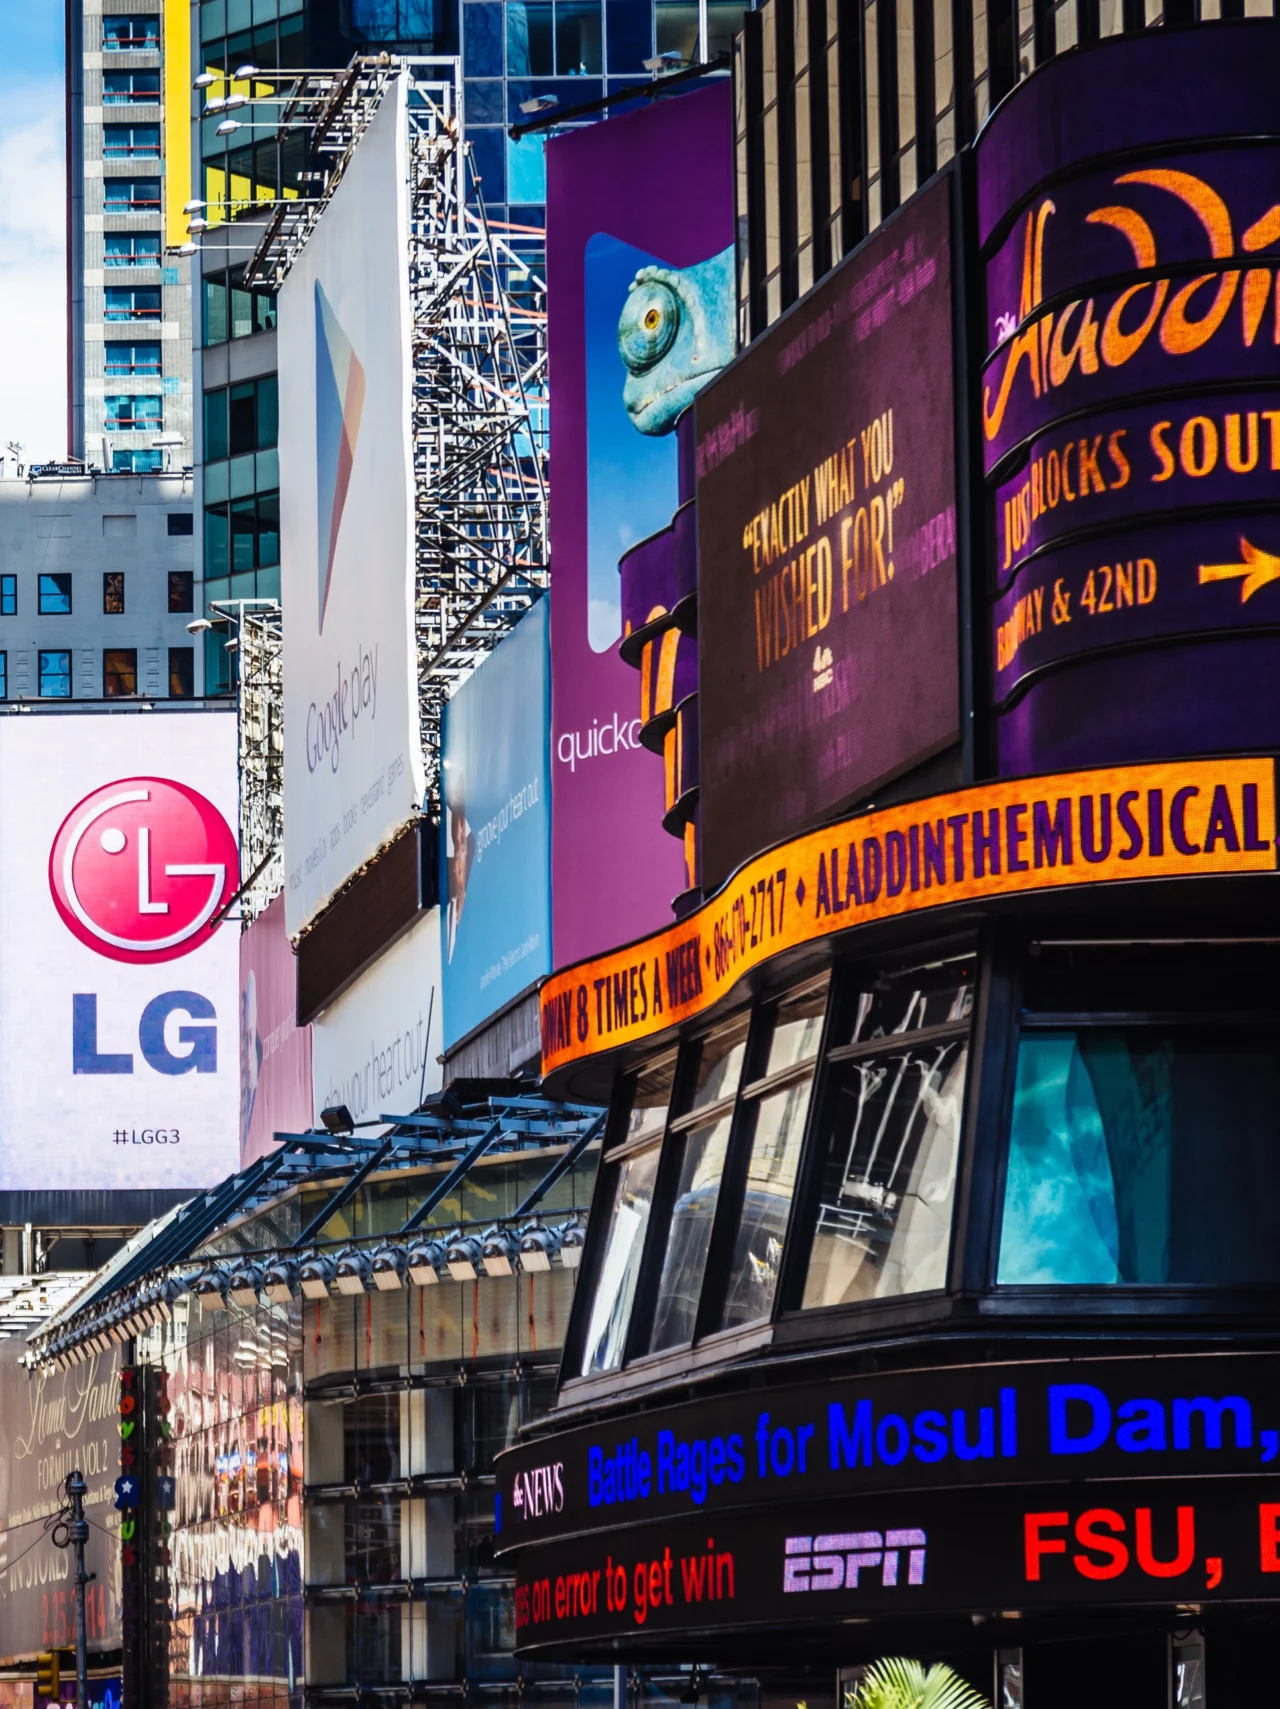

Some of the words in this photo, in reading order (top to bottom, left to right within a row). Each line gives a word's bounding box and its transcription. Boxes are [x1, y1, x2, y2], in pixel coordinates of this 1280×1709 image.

[983, 169, 1280, 441] Aladdi
[814, 437, 857, 527] WHAT
[860, 407, 895, 490] YOU
[1003, 480, 1031, 571] JUS
[1030, 427, 1132, 523] BLOCKS
[754, 535, 833, 674] WISHED
[1050, 577, 1072, 626] &
[1079, 557, 1159, 617] 42ND
[305, 659, 350, 776] Google
[350, 640, 380, 742] play
[71, 989, 218, 1076] LG
[576, 983, 589, 1044] 8
[592, 960, 649, 1037] TIMES
[651, 956, 664, 1016] A
[664, 934, 705, 1011] WEEK
[371, 1028, 403, 1102] heart
[403, 1009, 426, 1081] out
[111, 1127, 181, 1147] #LGG3
[82, 1441, 102, 1477] VOL
[102, 1439, 109, 1473] 2
[523, 1461, 565, 1521] NEWS
[587, 1435, 653, 1509] Battle
[656, 1428, 747, 1506] Rages
[755, 1410, 816, 1480] for
[827, 1385, 1019, 1472] Mosul
[1047, 1381, 1280, 1464] Dam,
[41, 1583, 107, 1646] 2.25.214
[532, 1576, 551, 1625] on
[554, 1568, 601, 1621] error
[605, 1555, 628, 1614] to
[633, 1546, 674, 1626] get
[680, 1536, 735, 1604] win
[782, 1526, 928, 1594] ESPN
[1023, 1506, 1224, 1591] FSU,
